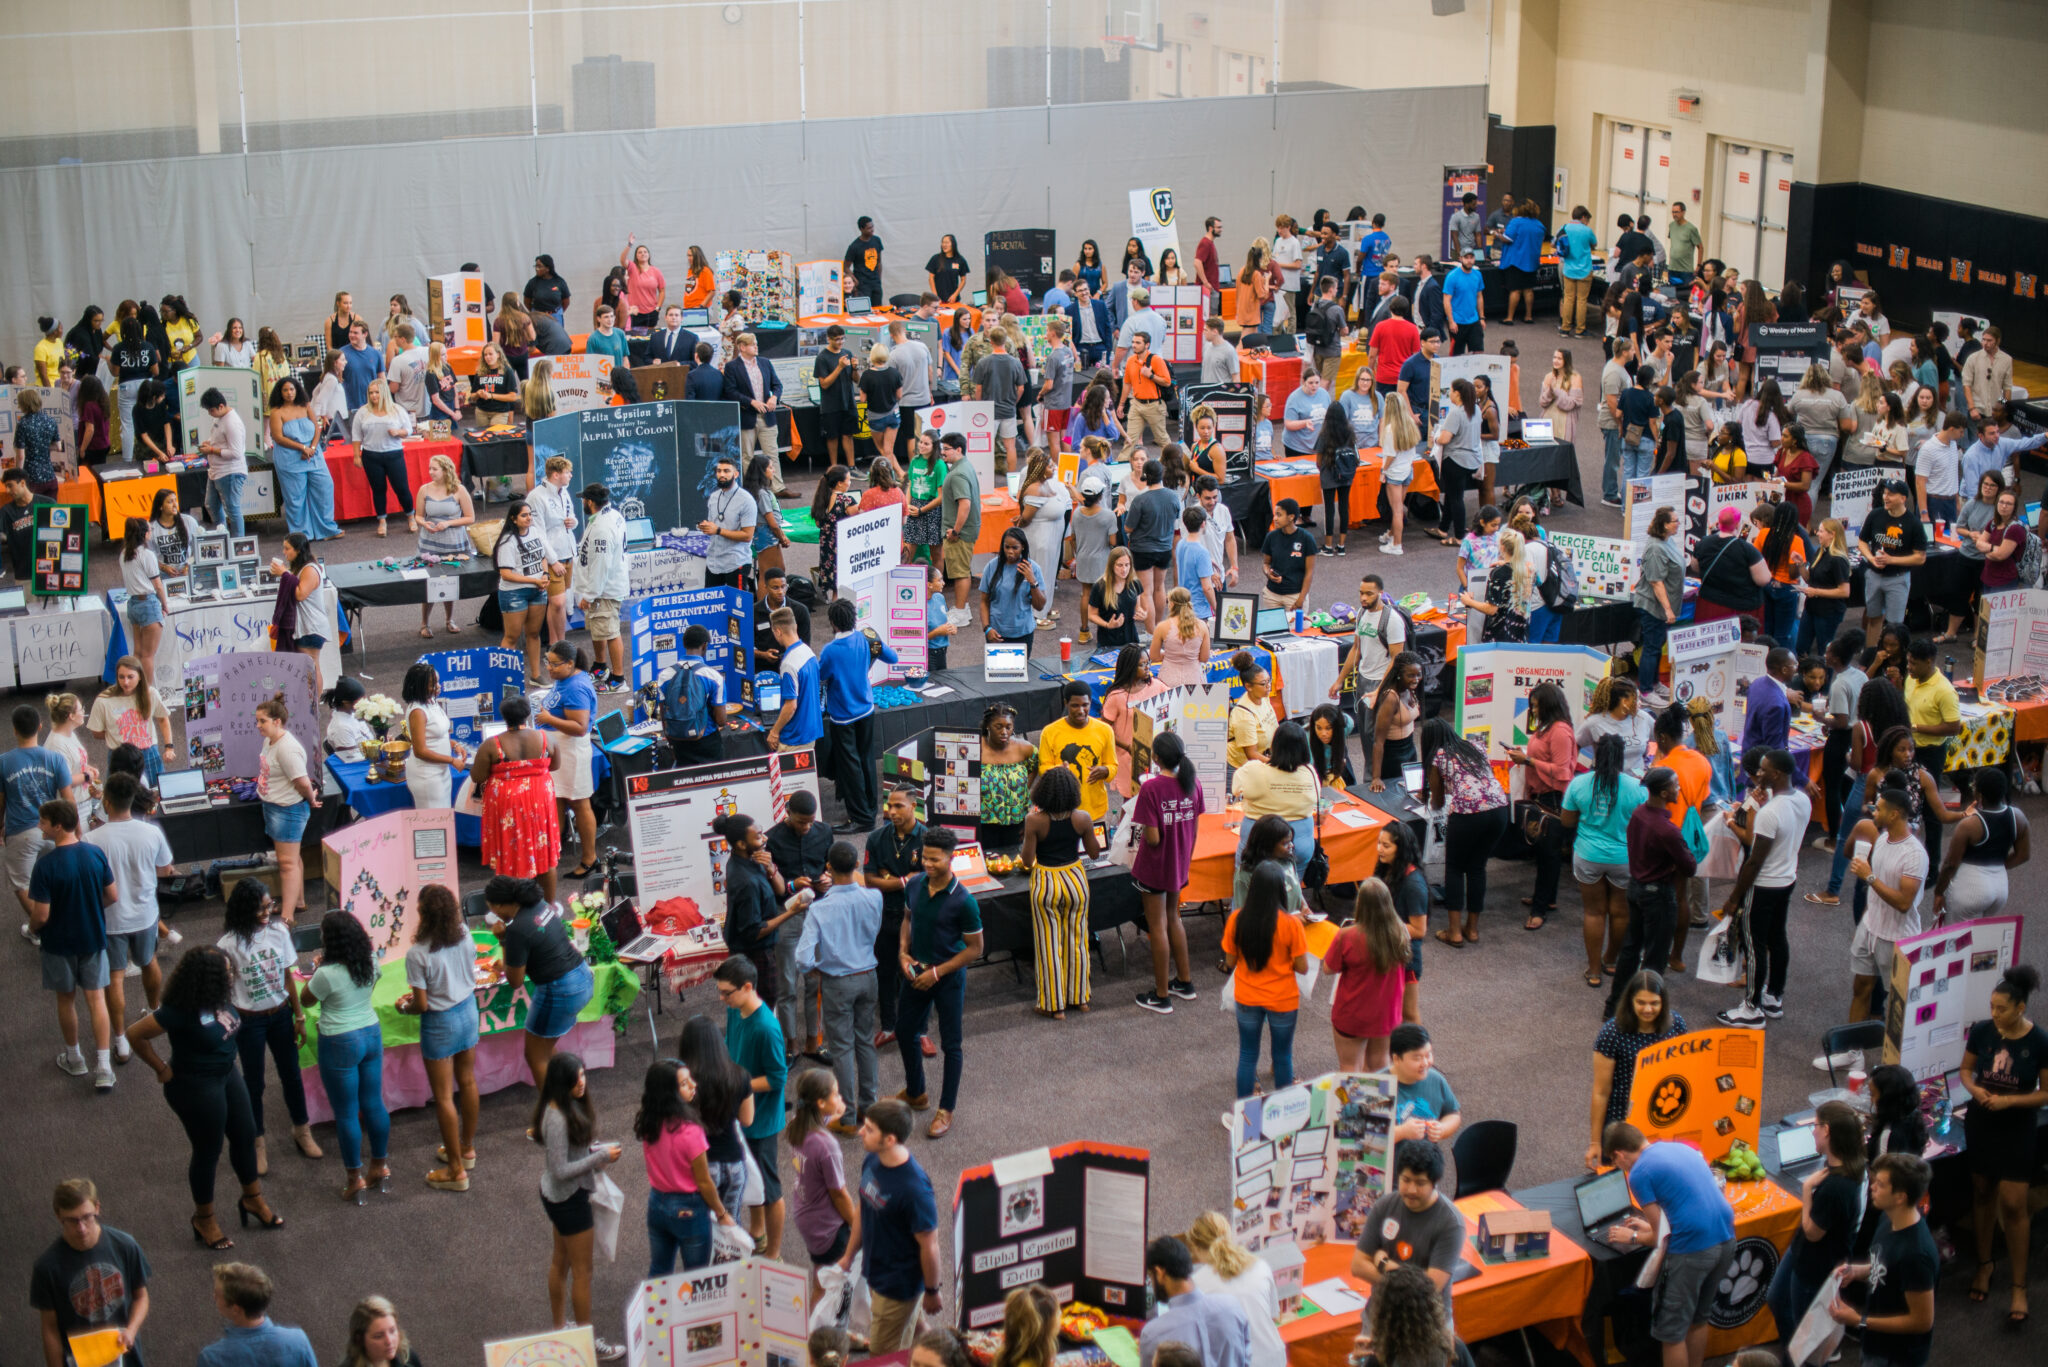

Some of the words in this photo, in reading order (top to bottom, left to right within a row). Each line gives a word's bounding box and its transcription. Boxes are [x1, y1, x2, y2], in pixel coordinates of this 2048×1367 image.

[1857, 242, 1883, 258] BEARS
[1916, 256, 1943, 271] BEARS
[1978, 269, 2007, 286] BEARS
[1769, 327, 1789, 336] Wesley
[120, 355, 150, 368] 2019
[555, 355, 585, 364] MERCER
[551, 370, 592, 380] VOLLEYBALL
[562, 363, 580, 372] CLUB
[479, 376, 504, 385] BEARS
[556, 388, 589, 399] TRYOUTS
[582, 411, 609, 424] Delta
[614, 407, 651, 422] Epsilon
[656, 403, 673, 418] Psi
[582, 432, 613, 442] ALPHA
[635, 425, 675, 436] COLONY
[608, 478, 653, 489] commitment
[1717, 484, 1748, 494] MERCER
[1835, 477, 1878, 491] PRE-PHARM
[1716, 491, 1748, 503] UKIRK
[847, 517, 890, 539] SOCIOLOGY
[1553, 535, 1596, 549] MERCER
[655, 554, 694, 566] UNIVERSITY
[849, 545, 885, 564] CRIMINAL
[1577, 548, 1615, 563] VEGAN
[850, 557, 881, 575] JUSTICE
[1591, 562, 1620, 575] CLUB
[652, 596, 671, 607] PHI
[671, 592, 698, 605] BETA
[698, 589, 726, 602] SIGMA
[29, 620, 75, 640] BETA
[654, 617, 690, 631] GAMMA
[1673, 630, 1696, 641] OMEGA
[1700, 624, 1715, 635] PSI
[1717, 621, 1732, 632] PHI
[175, 622, 226, 655] Sigma
[1676, 637, 1715, 652] FRATERNITY
[22, 642, 87, 666] ALPHA
[45, 659, 77, 681] PSI
[224, 655, 308, 683] PANHELLENIC
[447, 654, 472, 673] PHI
[489, 652, 522, 672] BETA
[1515, 666, 1565, 677] ORGANIZATION
[231, 692, 298, 703] COUNIL
[1183, 702, 1228, 719] Q&A
[673, 777, 695, 786] KAPPA
[695, 774, 713, 784] ALPHA
[713, 773, 722, 781] PSI
[722, 768, 756, 779] FRATERNITY,
[757, 765, 769, 775] INC.
[370, 913, 386, 928] 08
[250, 947, 279, 965] AKA
[1641, 1038, 1713, 1069] MERCER
[1983, 1070, 2020, 1085] WOMEN
[1283, 1101, 1307, 1111] Habitat
[977, 1250, 1015, 1270] Alpha
[1025, 1236, 1074, 1256] Epsilon
[1006, 1267, 1041, 1284] Delta
[692, 1273, 729, 1294] MU
[692, 1287, 728, 1304] MIRACLE
